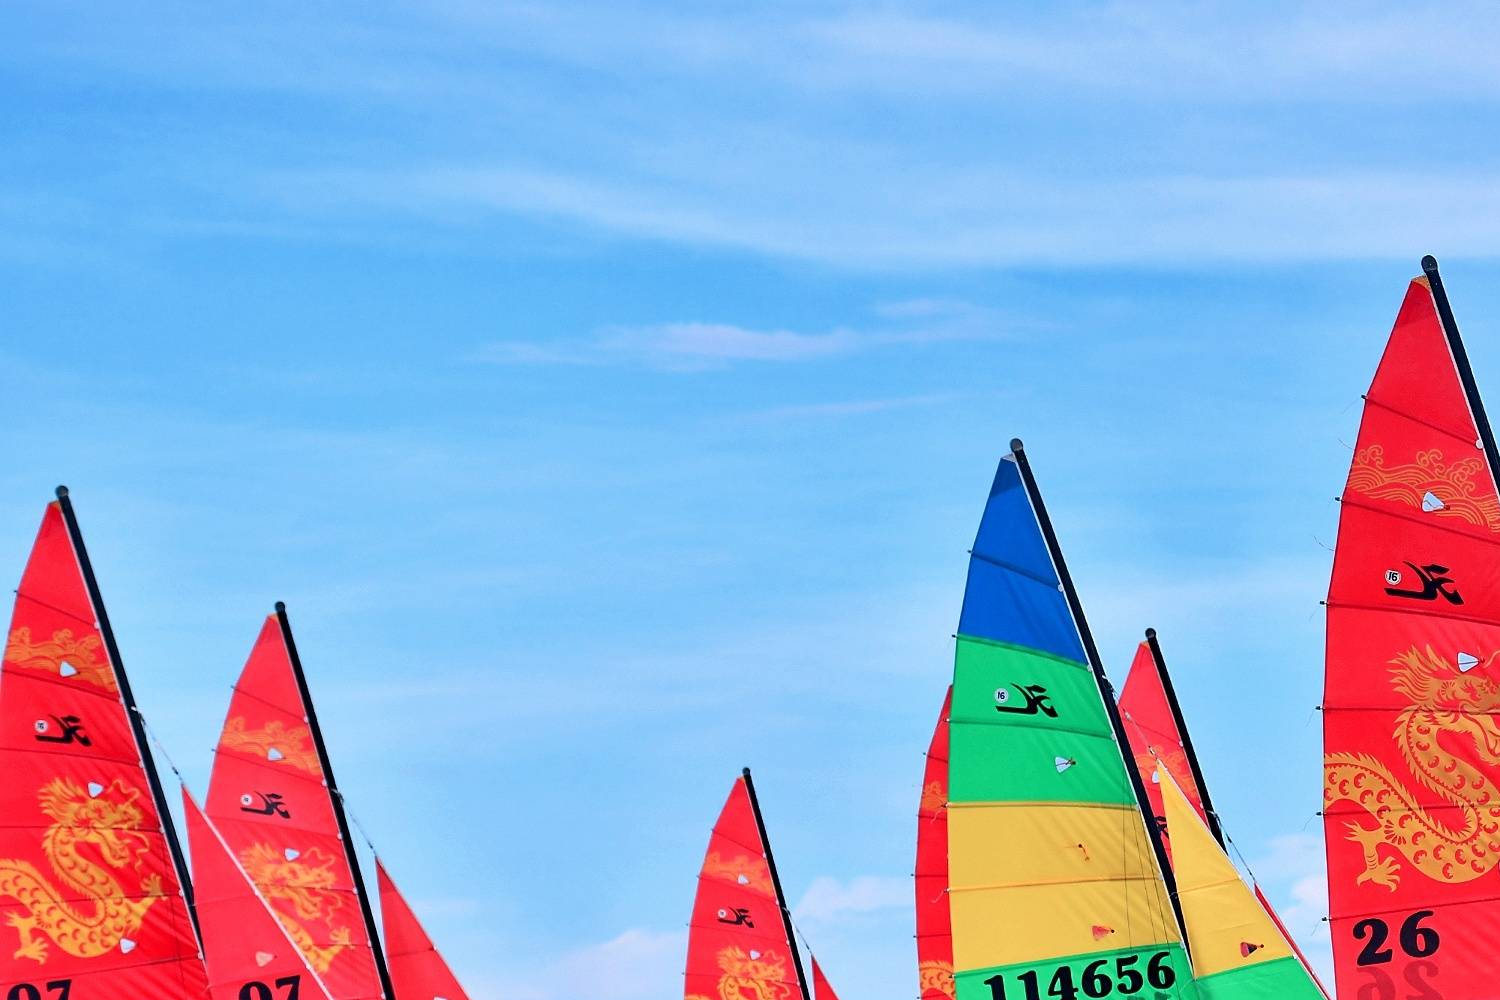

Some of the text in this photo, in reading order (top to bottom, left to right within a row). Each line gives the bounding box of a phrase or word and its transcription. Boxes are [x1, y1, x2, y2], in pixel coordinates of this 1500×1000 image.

[1388, 572, 1398, 582] 16
[997, 691, 1005, 700] 16
[1352, 910, 1440, 967] 26
